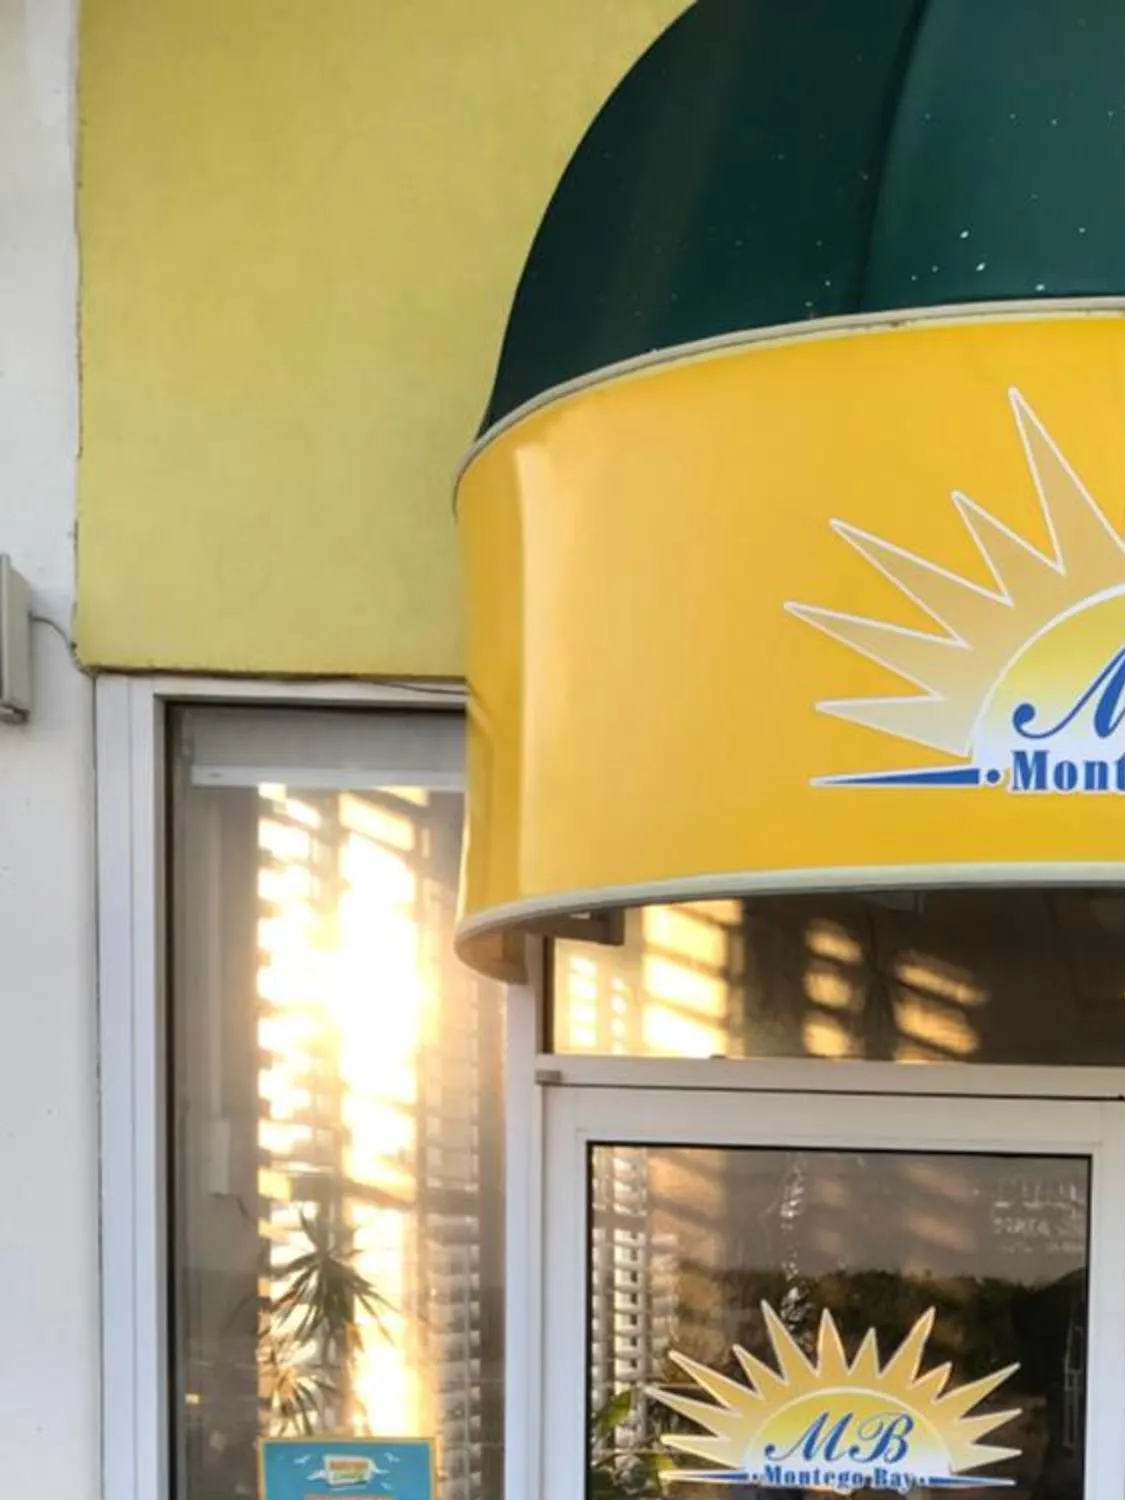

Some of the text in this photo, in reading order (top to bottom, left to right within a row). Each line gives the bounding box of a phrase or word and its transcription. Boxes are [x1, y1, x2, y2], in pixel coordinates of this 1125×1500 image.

[764, 1411, 914, 1463] MB
[764, 1465, 914, 1492] Montego Bay
